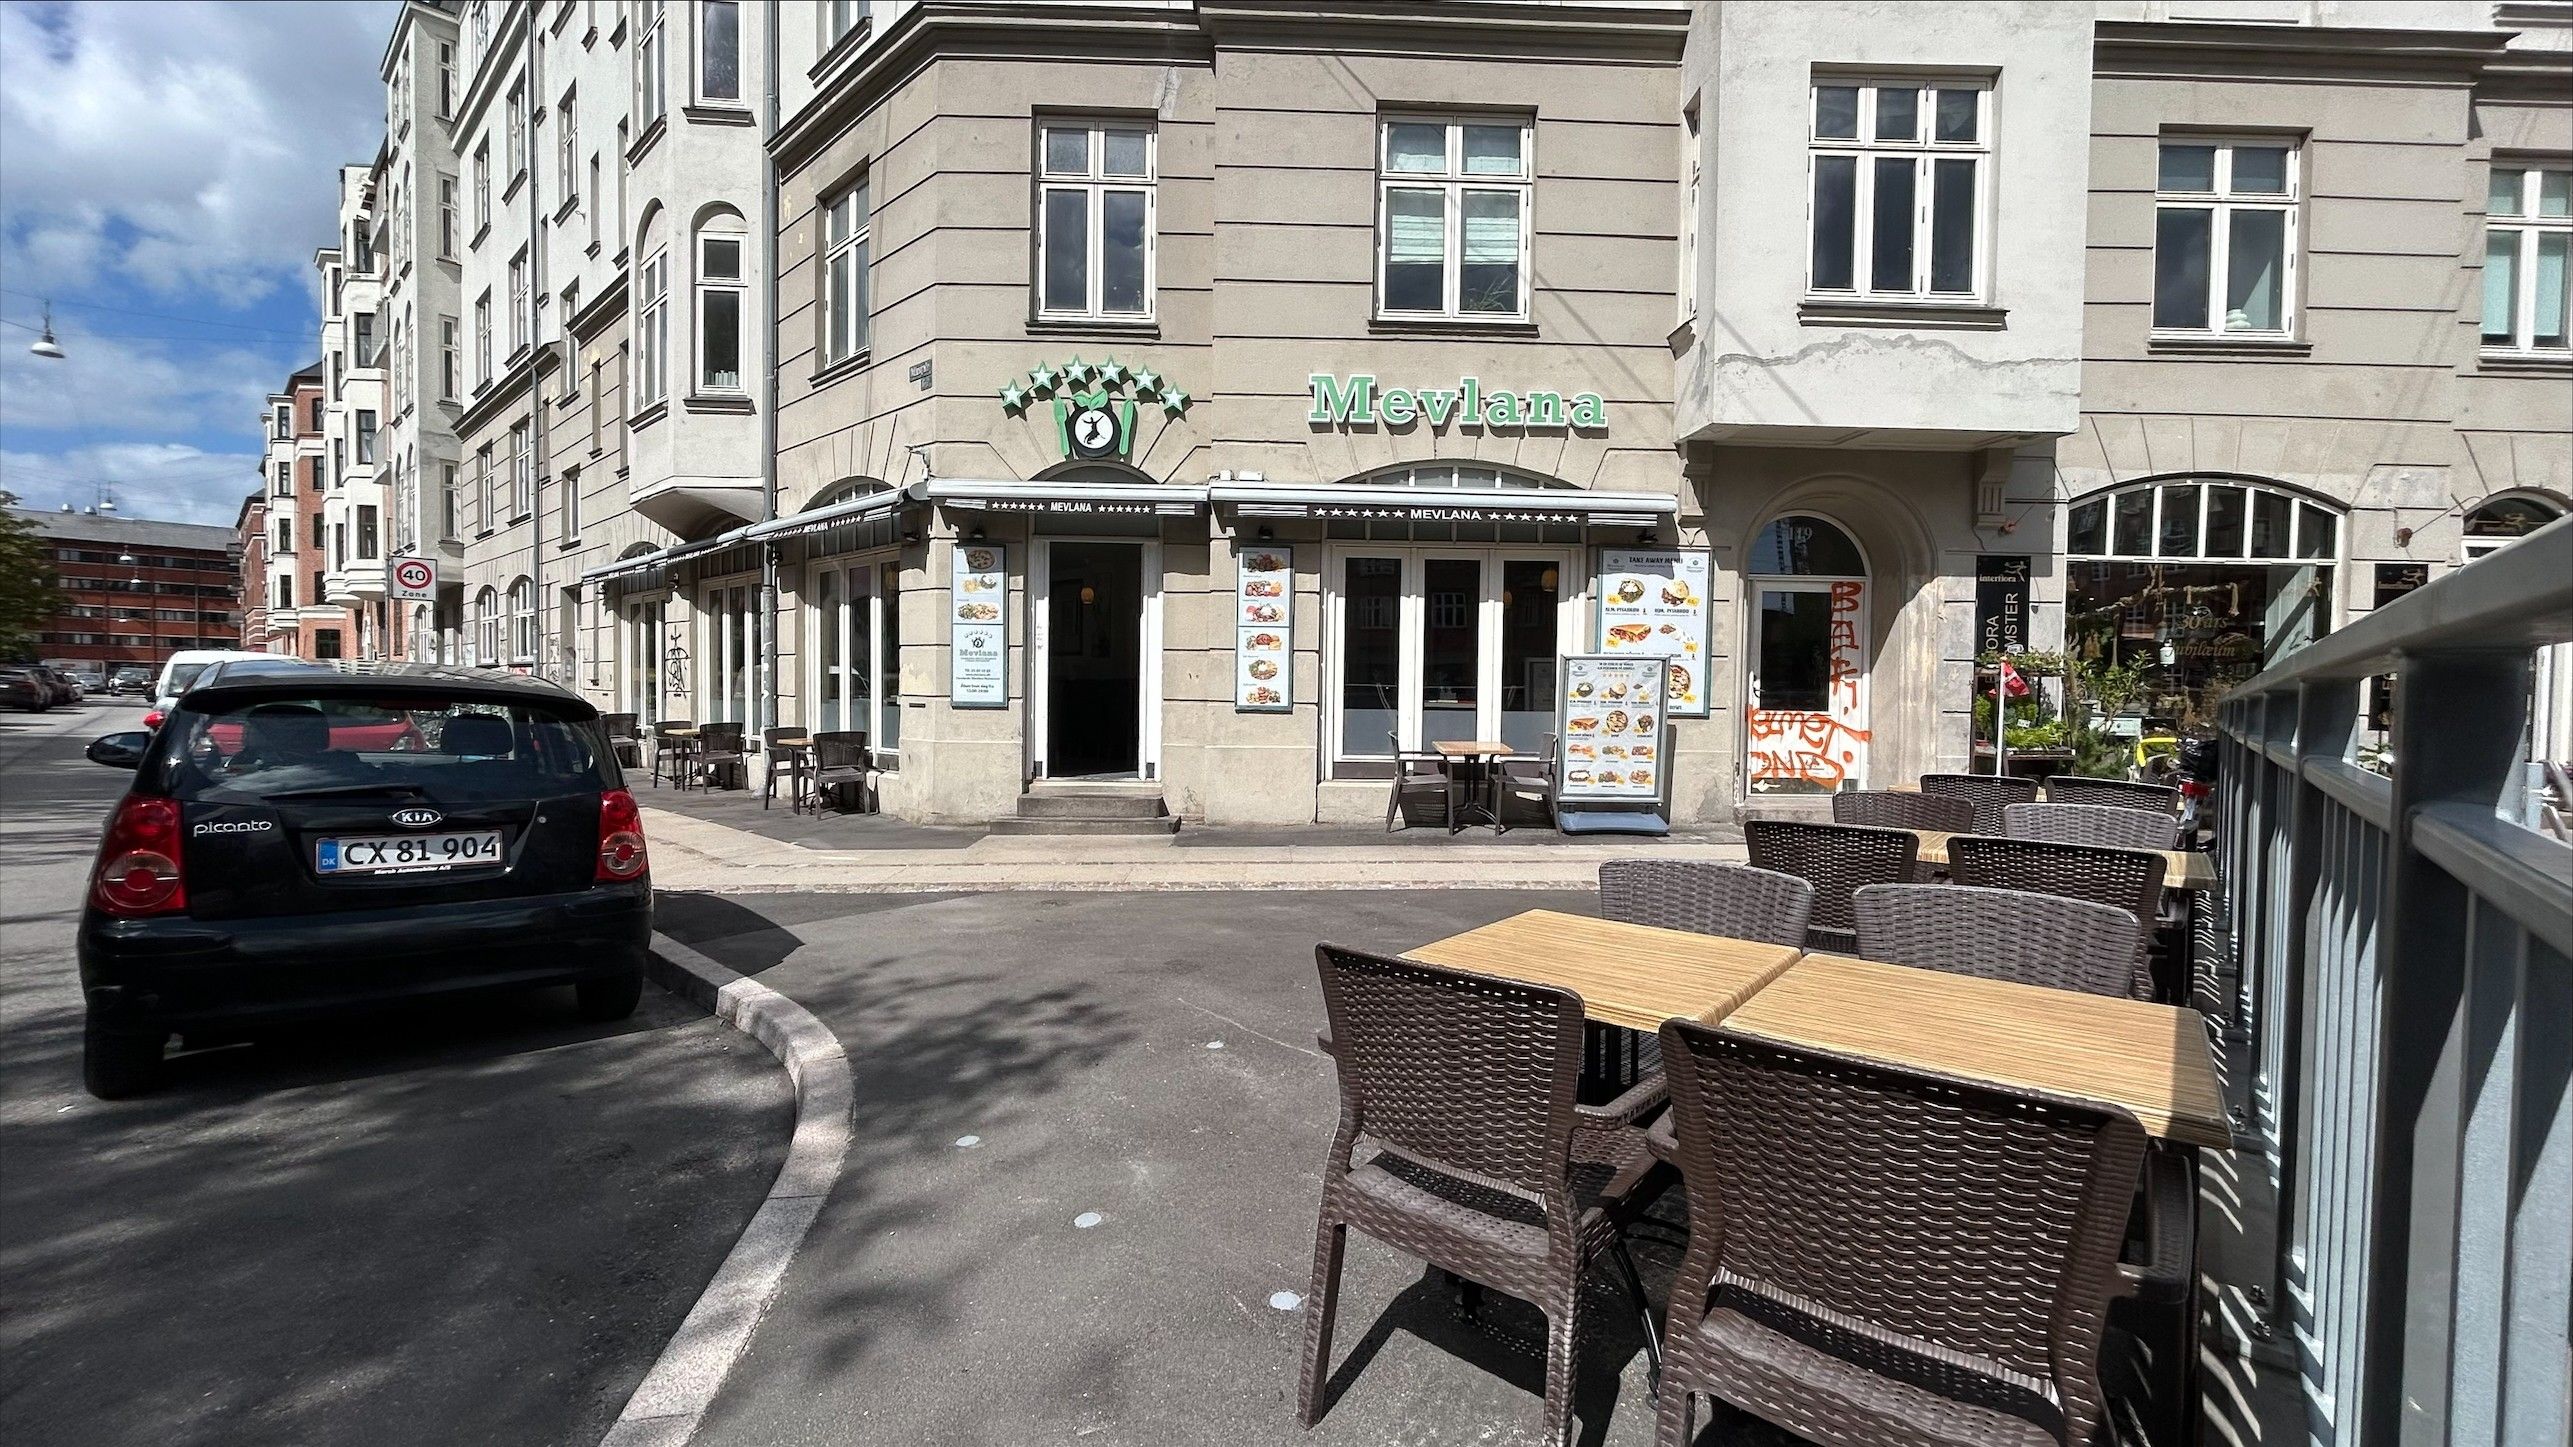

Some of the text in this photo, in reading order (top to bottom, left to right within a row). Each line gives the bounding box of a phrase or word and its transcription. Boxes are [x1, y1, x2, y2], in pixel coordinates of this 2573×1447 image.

[1308, 373, 1609, 428] Mevlana
[1050, 502, 1092, 512] MEVLANA
[1410, 508, 1482, 521] MEVLANA
[403, 569, 426, 581] 40
[402, 590, 427, 598] Zone
[2004, 592, 2018, 648] MSTER
[1986, 615, 1999, 649] ORA
[401, 812, 433, 822] KIA
[193, 819, 273, 838] picanto
[343, 835, 498, 866] CX 81 904
[322, 857, 336, 866] DK
